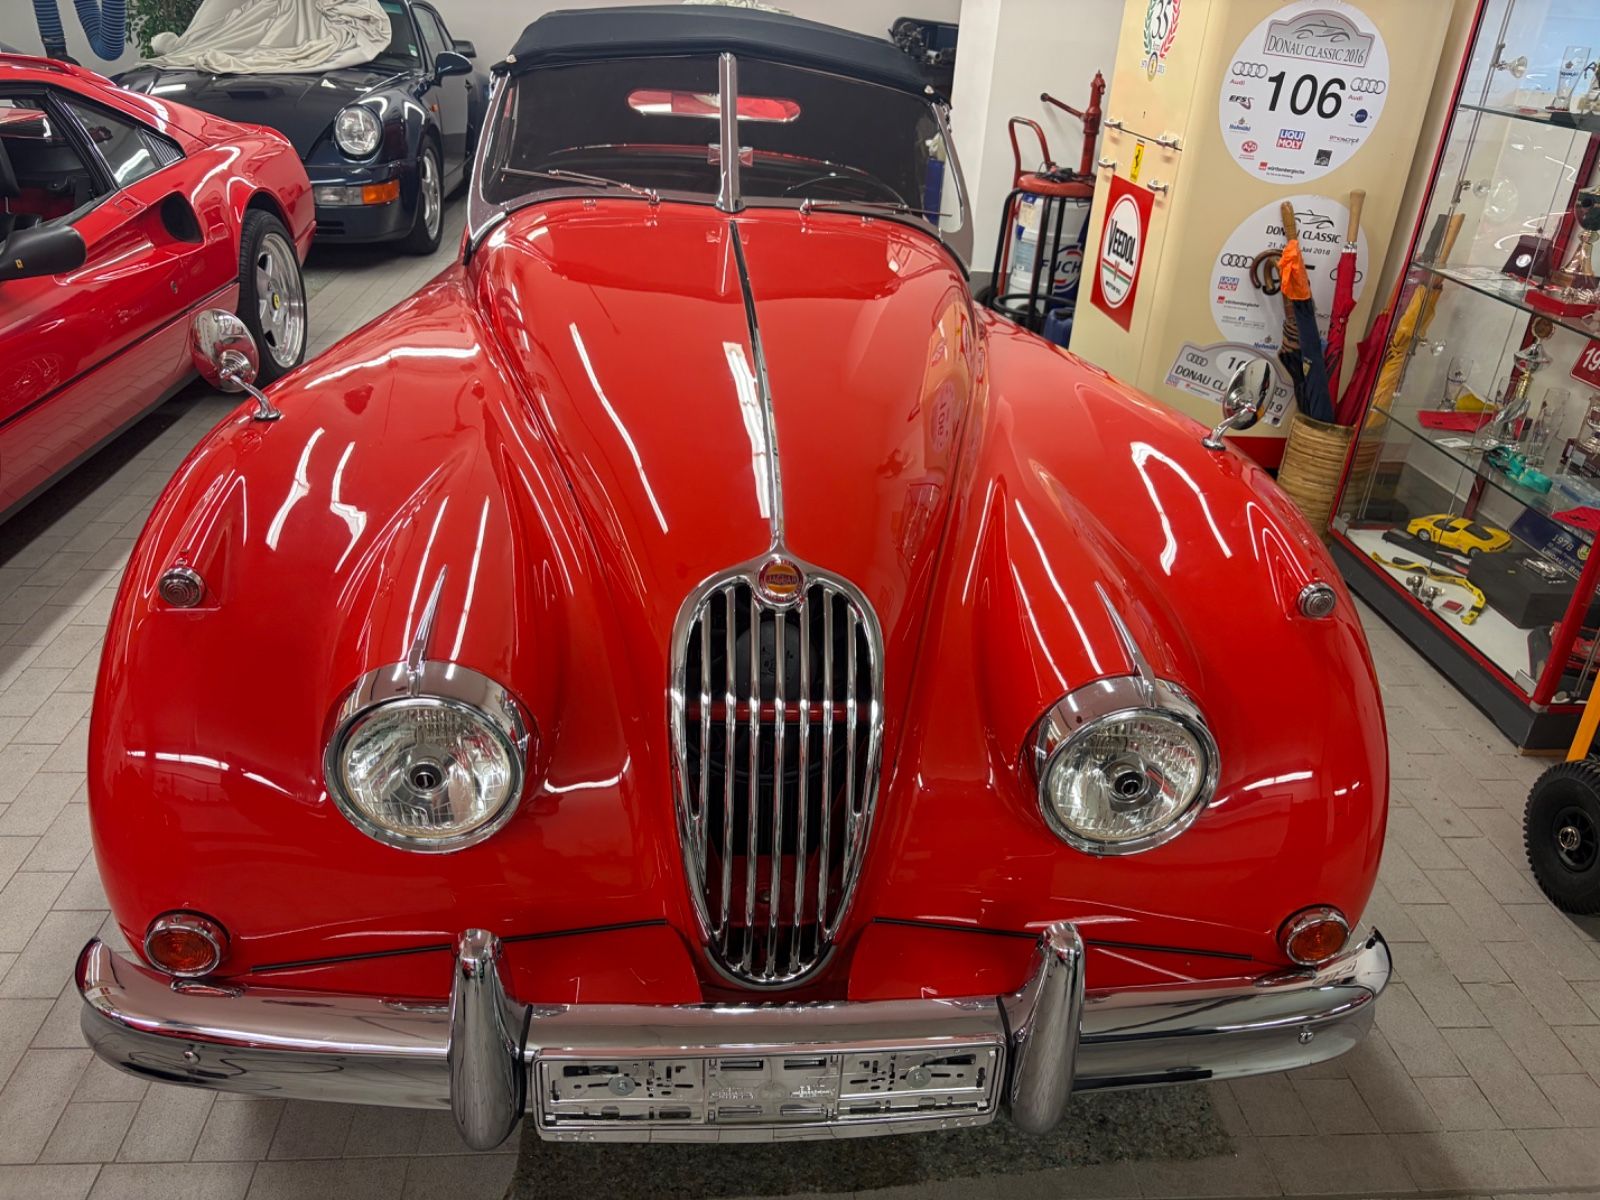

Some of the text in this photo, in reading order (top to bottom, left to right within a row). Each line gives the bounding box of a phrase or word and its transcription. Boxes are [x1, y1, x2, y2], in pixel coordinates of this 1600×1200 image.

[1151, 0, 1172, 40] 35
[1267, 35, 1366, 64] DONAU CLASSIC 2016
[1229, 78, 1245, 86] Audi
[1268, 71, 1346, 119] 106
[1280, 130, 1304, 140] LIQUI
[1278, 139, 1302, 149] MOLY
[1107, 218, 1135, 266] VEEDOL
[1302, 230, 1341, 244] CLASSIC
[1313, 248, 1331, 256] 2018
[1174, 365, 1212, 385] DONAU
